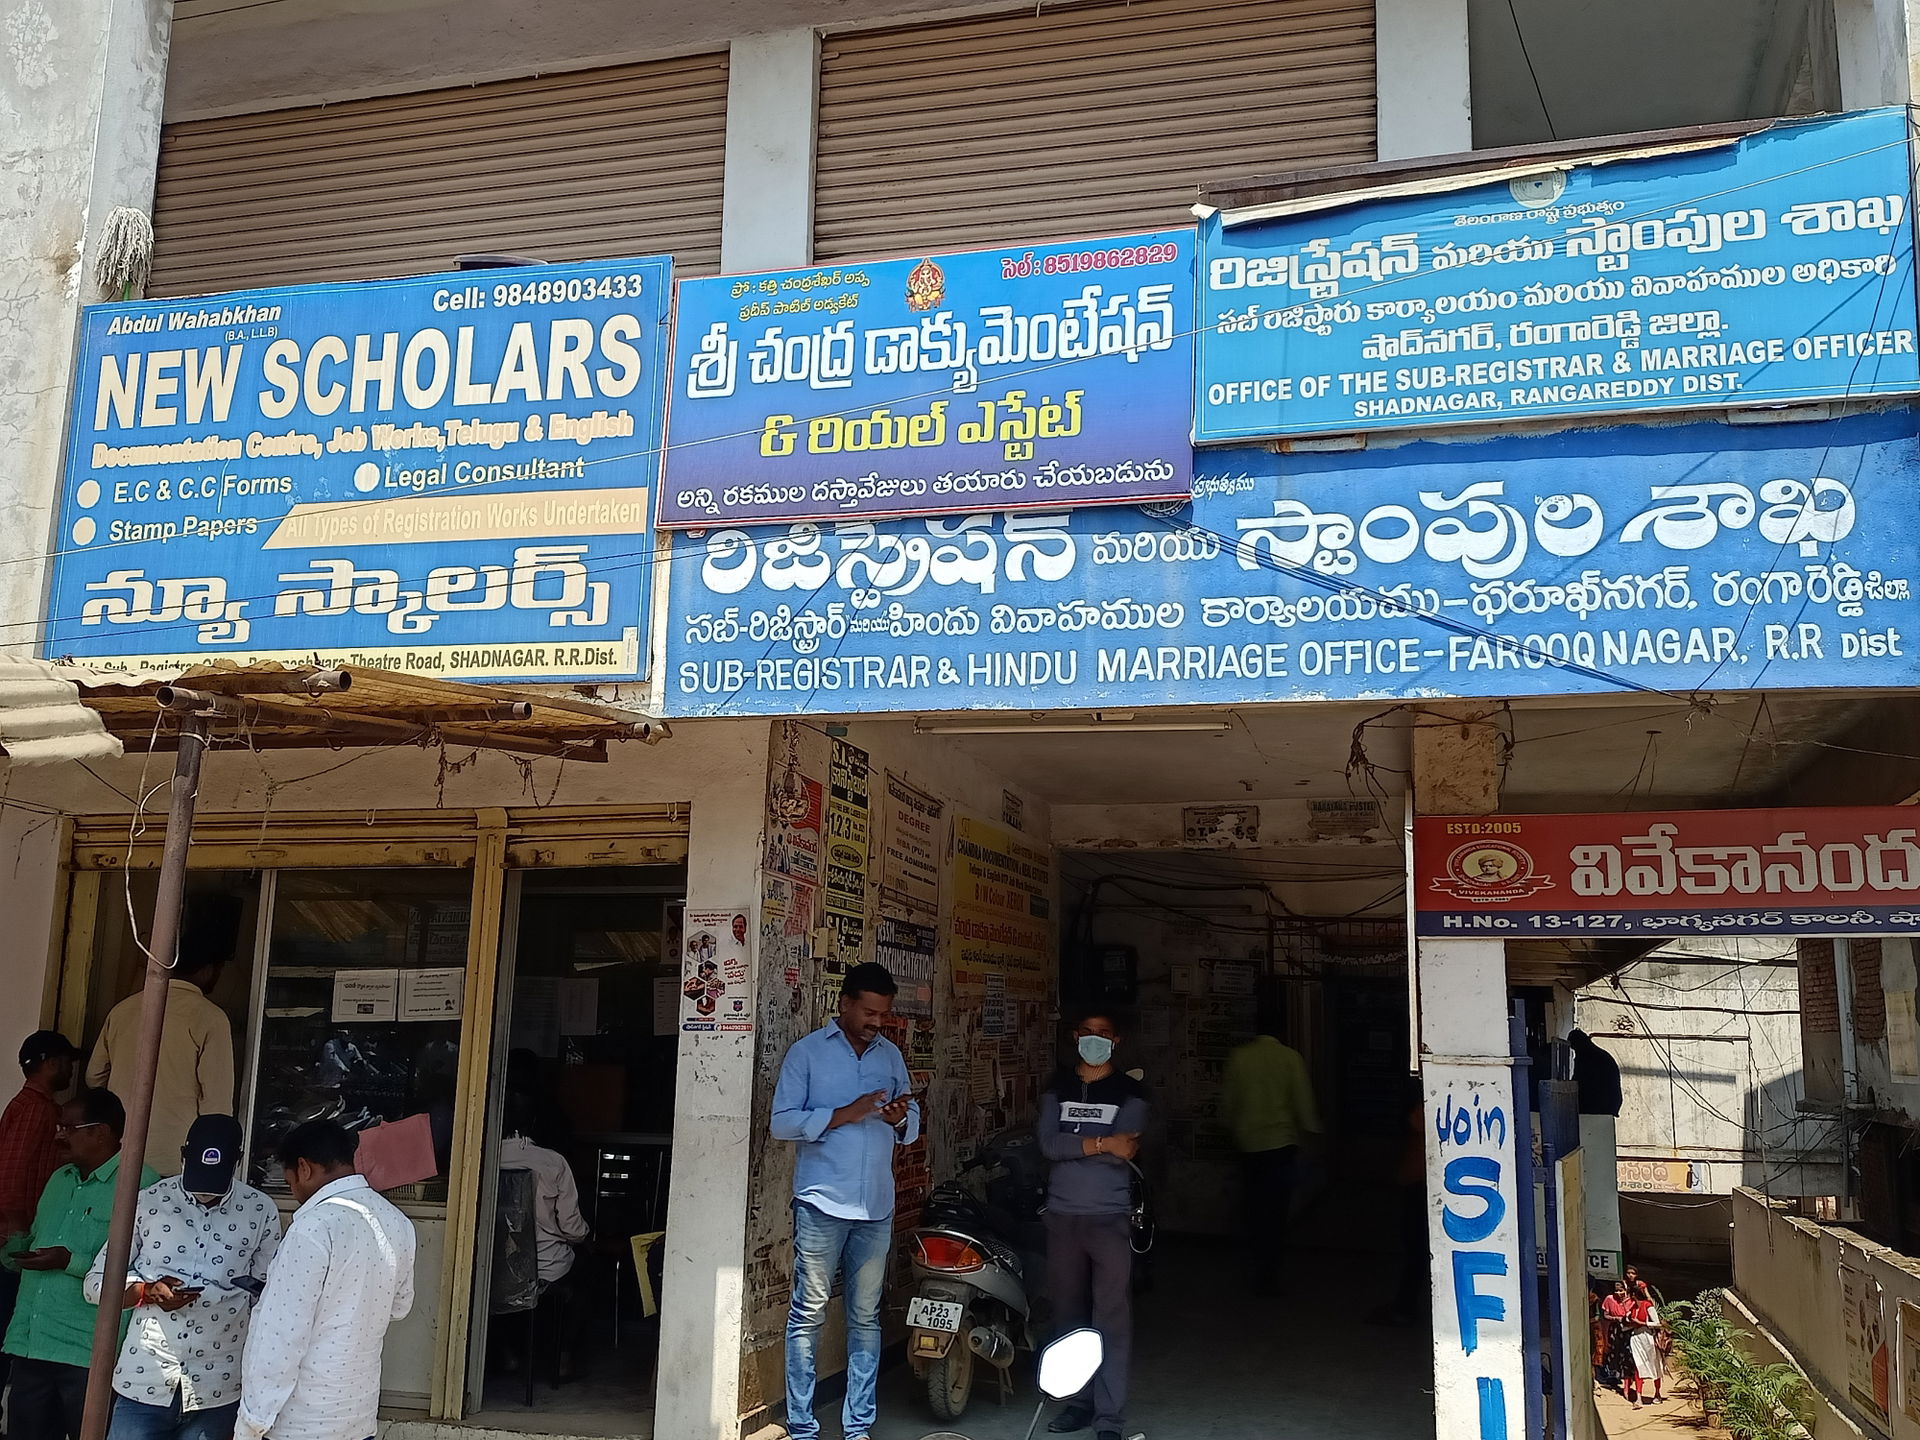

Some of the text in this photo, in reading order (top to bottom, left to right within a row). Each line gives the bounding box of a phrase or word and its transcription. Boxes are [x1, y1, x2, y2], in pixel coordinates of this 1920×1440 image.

[1043, 241, 1178, 276] 8519862829
[1208, 194, 1905, 300] రిజిస్ట్రేషన్ మరియు స్టాంపుల శాఖ
[433, 273, 643, 313] Cell: 9848903433
[1216, 303, 1261, 335] సబ్
[1366, 286, 1517, 324] కార్యాలయం
[1523, 275, 1625, 308] మరియు
[1630, 263, 1787, 298] వివాహముల
[1792, 253, 1897, 285] అధికారి
[107, 304, 282, 337] Abdul Wahabkhan
[685, 283, 1175, 400] శ్రీ చంద్ర డాక్యుమెంటేషన్
[1509, 308, 1641, 349] రంగారెడ్డి
[92, 312, 643, 432] NEW SCHOLARS
[1208, 328, 1916, 406] OFFICE OF THE SUB-REGISTRAR & MARRIAGE OFFICER
[1354, 372, 1744, 418] SHADNAGAR, RANGAREDDY DIST.
[91, 434, 243, 469] Documentation
[245, 429, 323, 461] Centre,
[326, 426, 368, 454] Job
[524, 413, 544, 442] &
[548, 409, 635, 446] English
[807, 399, 950, 455] రియల్
[957, 388, 1085, 462] ఎస్టేట్
[113, 474, 293, 504] E.C & C.C Forms
[384, 456, 585, 491] Legal Consultant
[677, 458, 1175, 515] అన్ని రకముల దస్తావేజులు తయారు చేయబడును
[109, 515, 258, 543] Stamp Papers
[285, 499, 641, 544] All Types of Registration Works Undertaken
[1091, 527, 1221, 566] మరియు
[1235, 479, 1604, 580] స్టాంపుల
[1619, 476, 1858, 560] శాఖ
[80, 543, 611, 645] న్యూ స్కాలర్స్
[989, 596, 1186, 635] వివాహముల
[350, 652, 401, 670] Theatre
[406, 652, 445, 673] Road,
[450, 648, 550, 669] SHADNAGAR.
[679, 655, 931, 694] SUB-REGISTRAR
[936, 656, 961, 685] &
[967, 649, 1078, 687] HINDU
[1096, 643, 1289, 683] MARRIAGE
[1841, 626, 1904, 660] Dist
[898, 810, 931, 835] DEGREE
[1458, 888, 1526, 897] VIVEKANANDA
[1442, 914, 1519, 930] H.No.
[1527, 913, 1632, 931] 13-127,
[1436, 1094, 1507, 1151] Join
[913, 1314, 953, 1330] L 1095
[920, 1304, 950, 1319] AP23
